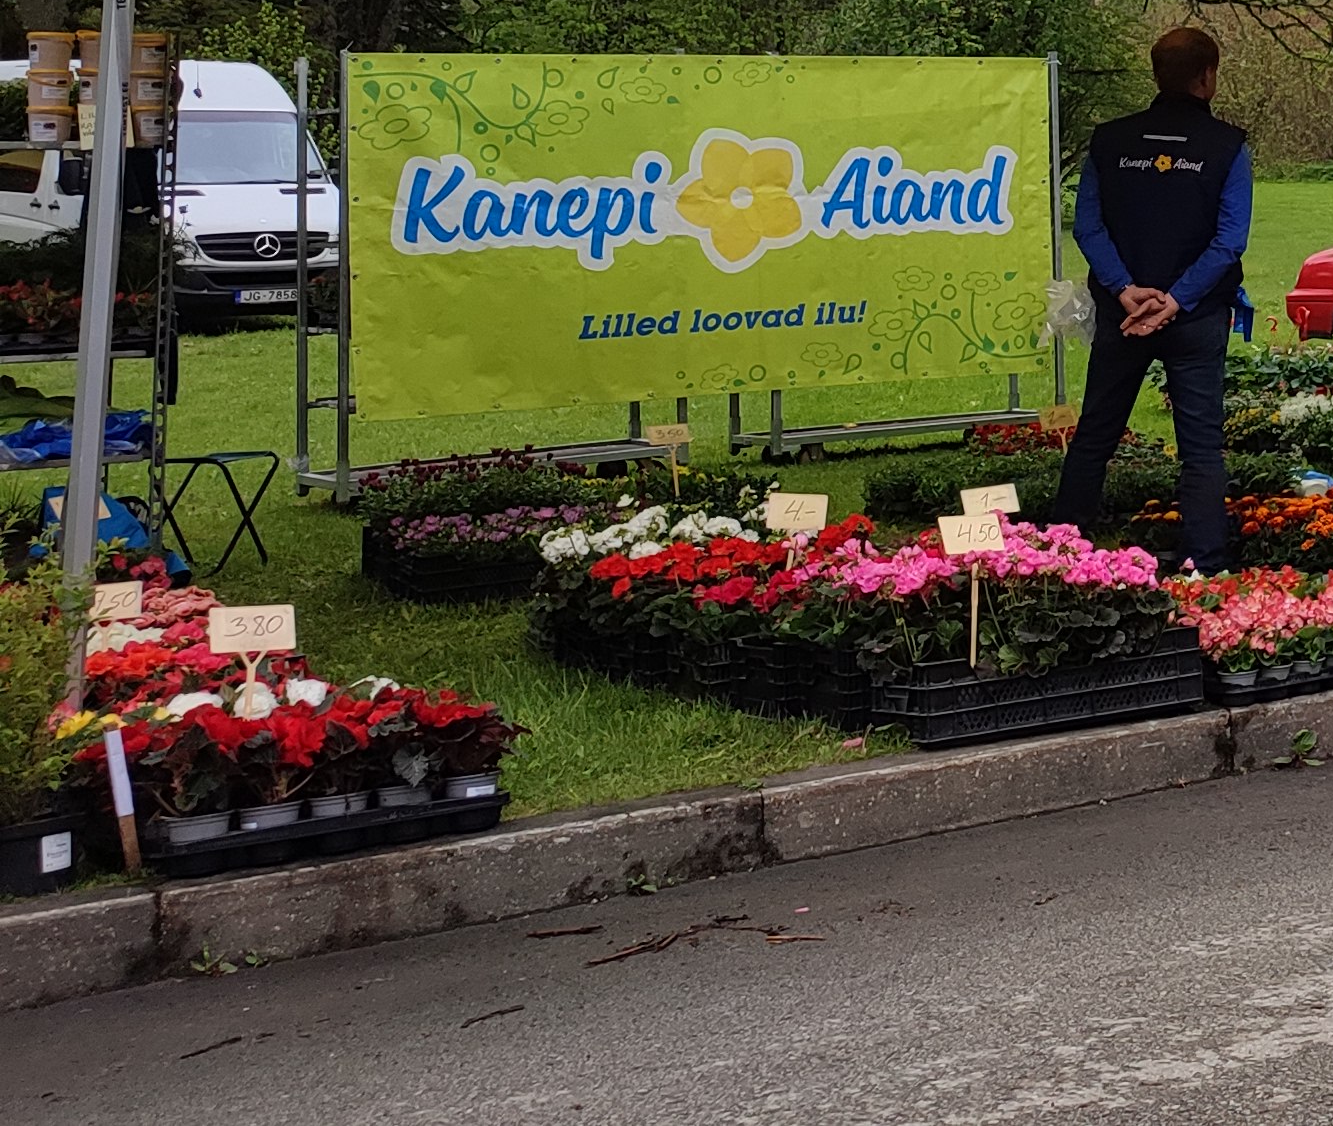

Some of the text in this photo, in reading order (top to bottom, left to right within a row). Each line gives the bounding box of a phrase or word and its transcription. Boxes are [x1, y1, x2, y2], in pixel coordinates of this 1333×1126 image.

[1119, 157, 1204, 173] Kanepi Aiand
[403, 155, 1008, 260] Kanepi Aiand
[578, 300, 868, 340] Lilled loovad ilu!
[957, 523, 1000, 543] 4.50
[224, 615, 284, 637] 3.80
